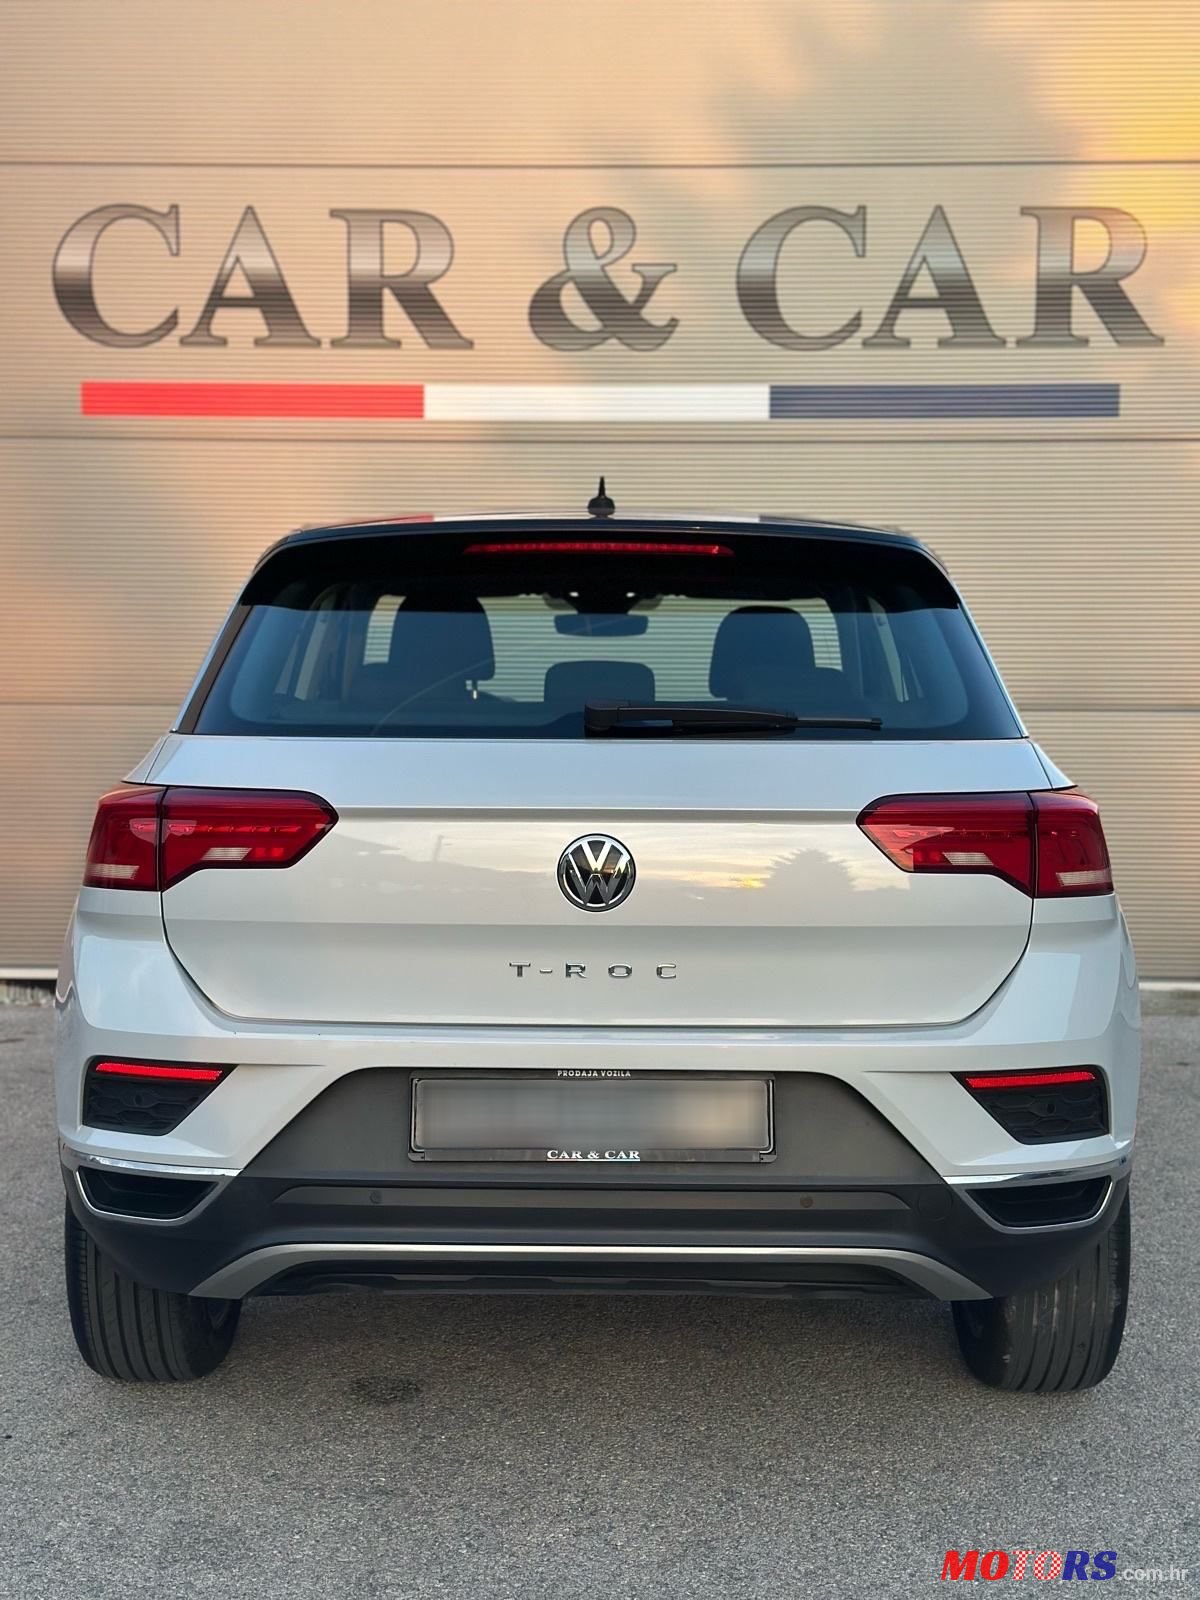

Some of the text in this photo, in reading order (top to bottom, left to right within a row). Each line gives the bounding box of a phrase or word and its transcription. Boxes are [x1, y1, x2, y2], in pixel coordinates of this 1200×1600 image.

[52, 203, 1165, 352] CAR & CAR
[559, 835, 635, 911] VW
[508, 961, 677, 980] T-ROC
[557, 1069, 632, 1077] PRODAJA VOZILA
[546, 1149, 640, 1159] CAR & CAR
